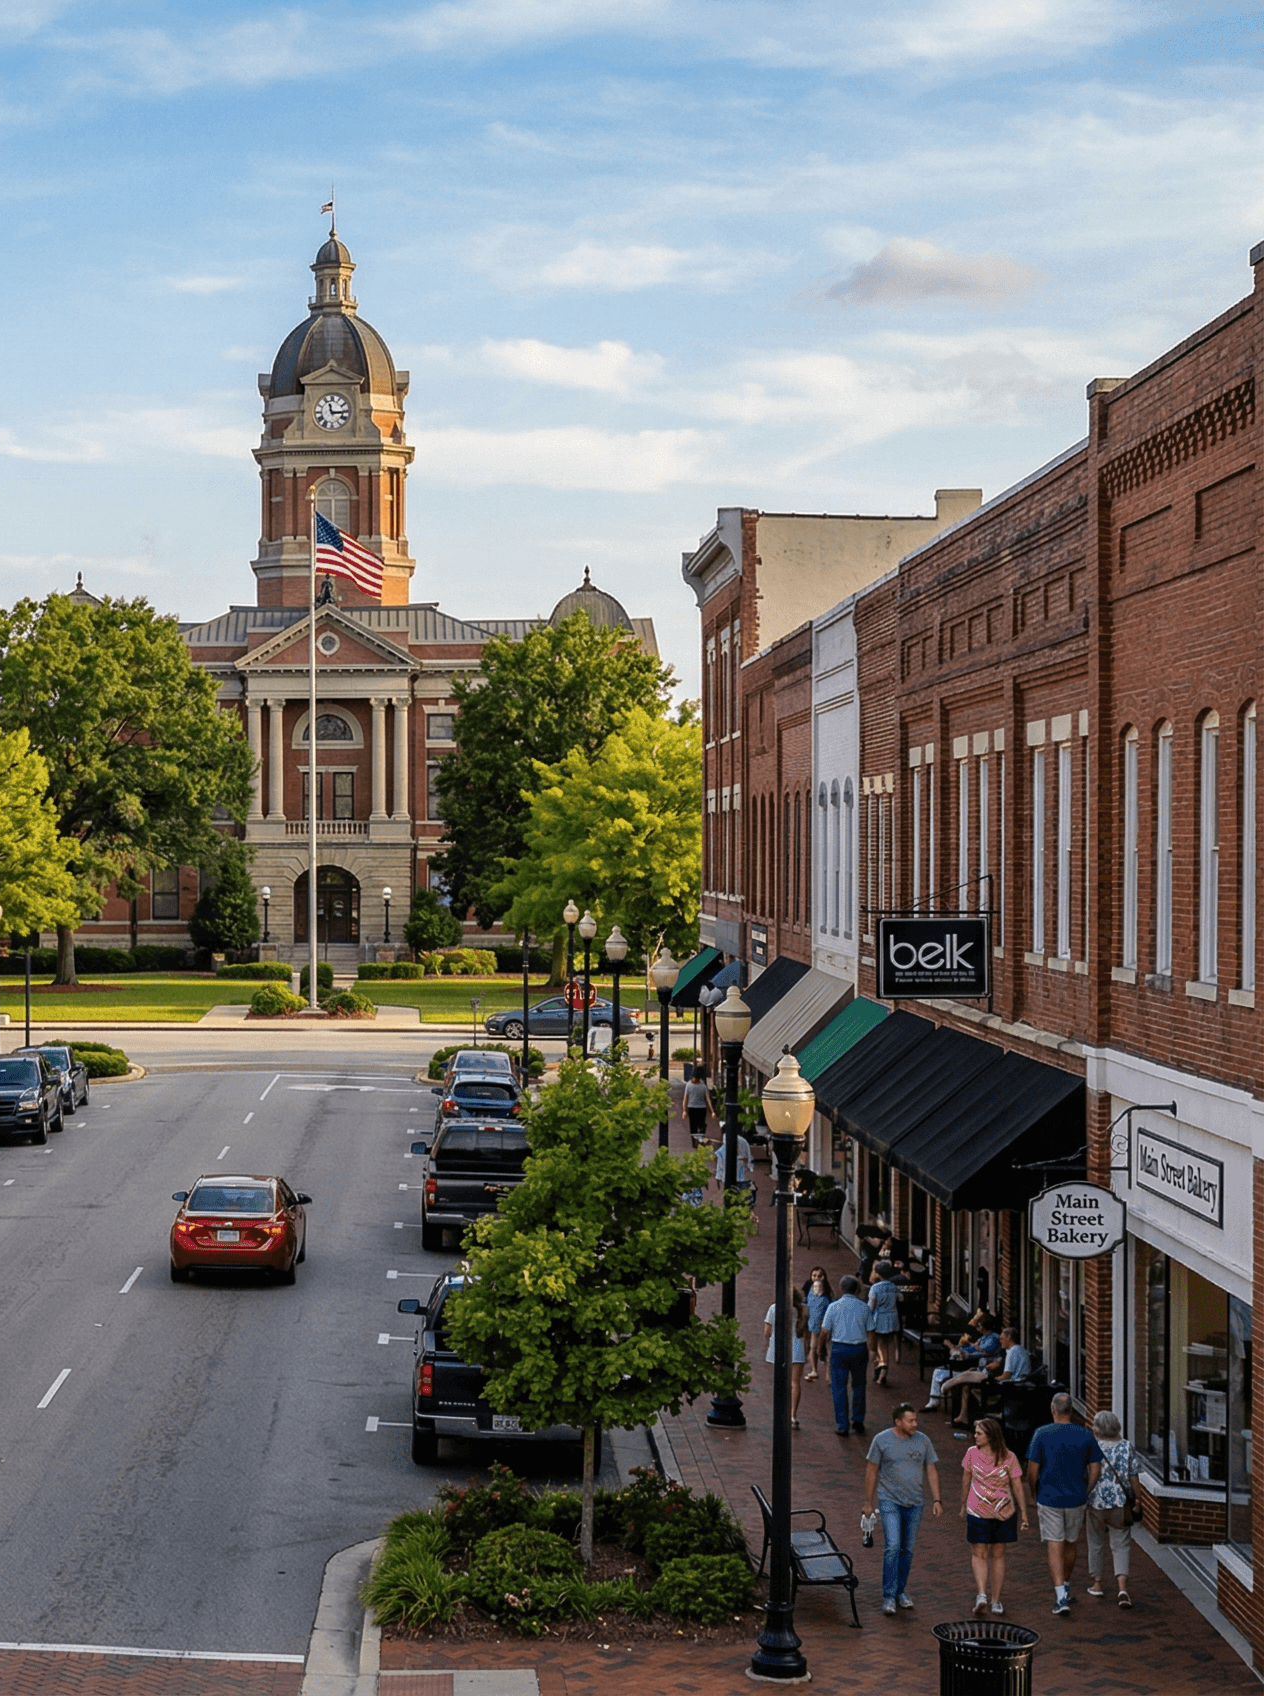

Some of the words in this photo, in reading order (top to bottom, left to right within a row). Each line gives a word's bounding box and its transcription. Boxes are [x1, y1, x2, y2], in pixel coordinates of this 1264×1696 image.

[889, 933, 975, 970] belk
[1055, 1193, 1100, 1209] Main
[1051, 1210, 1105, 1226] Street
[1047, 1228, 1109, 1248] Bakery
